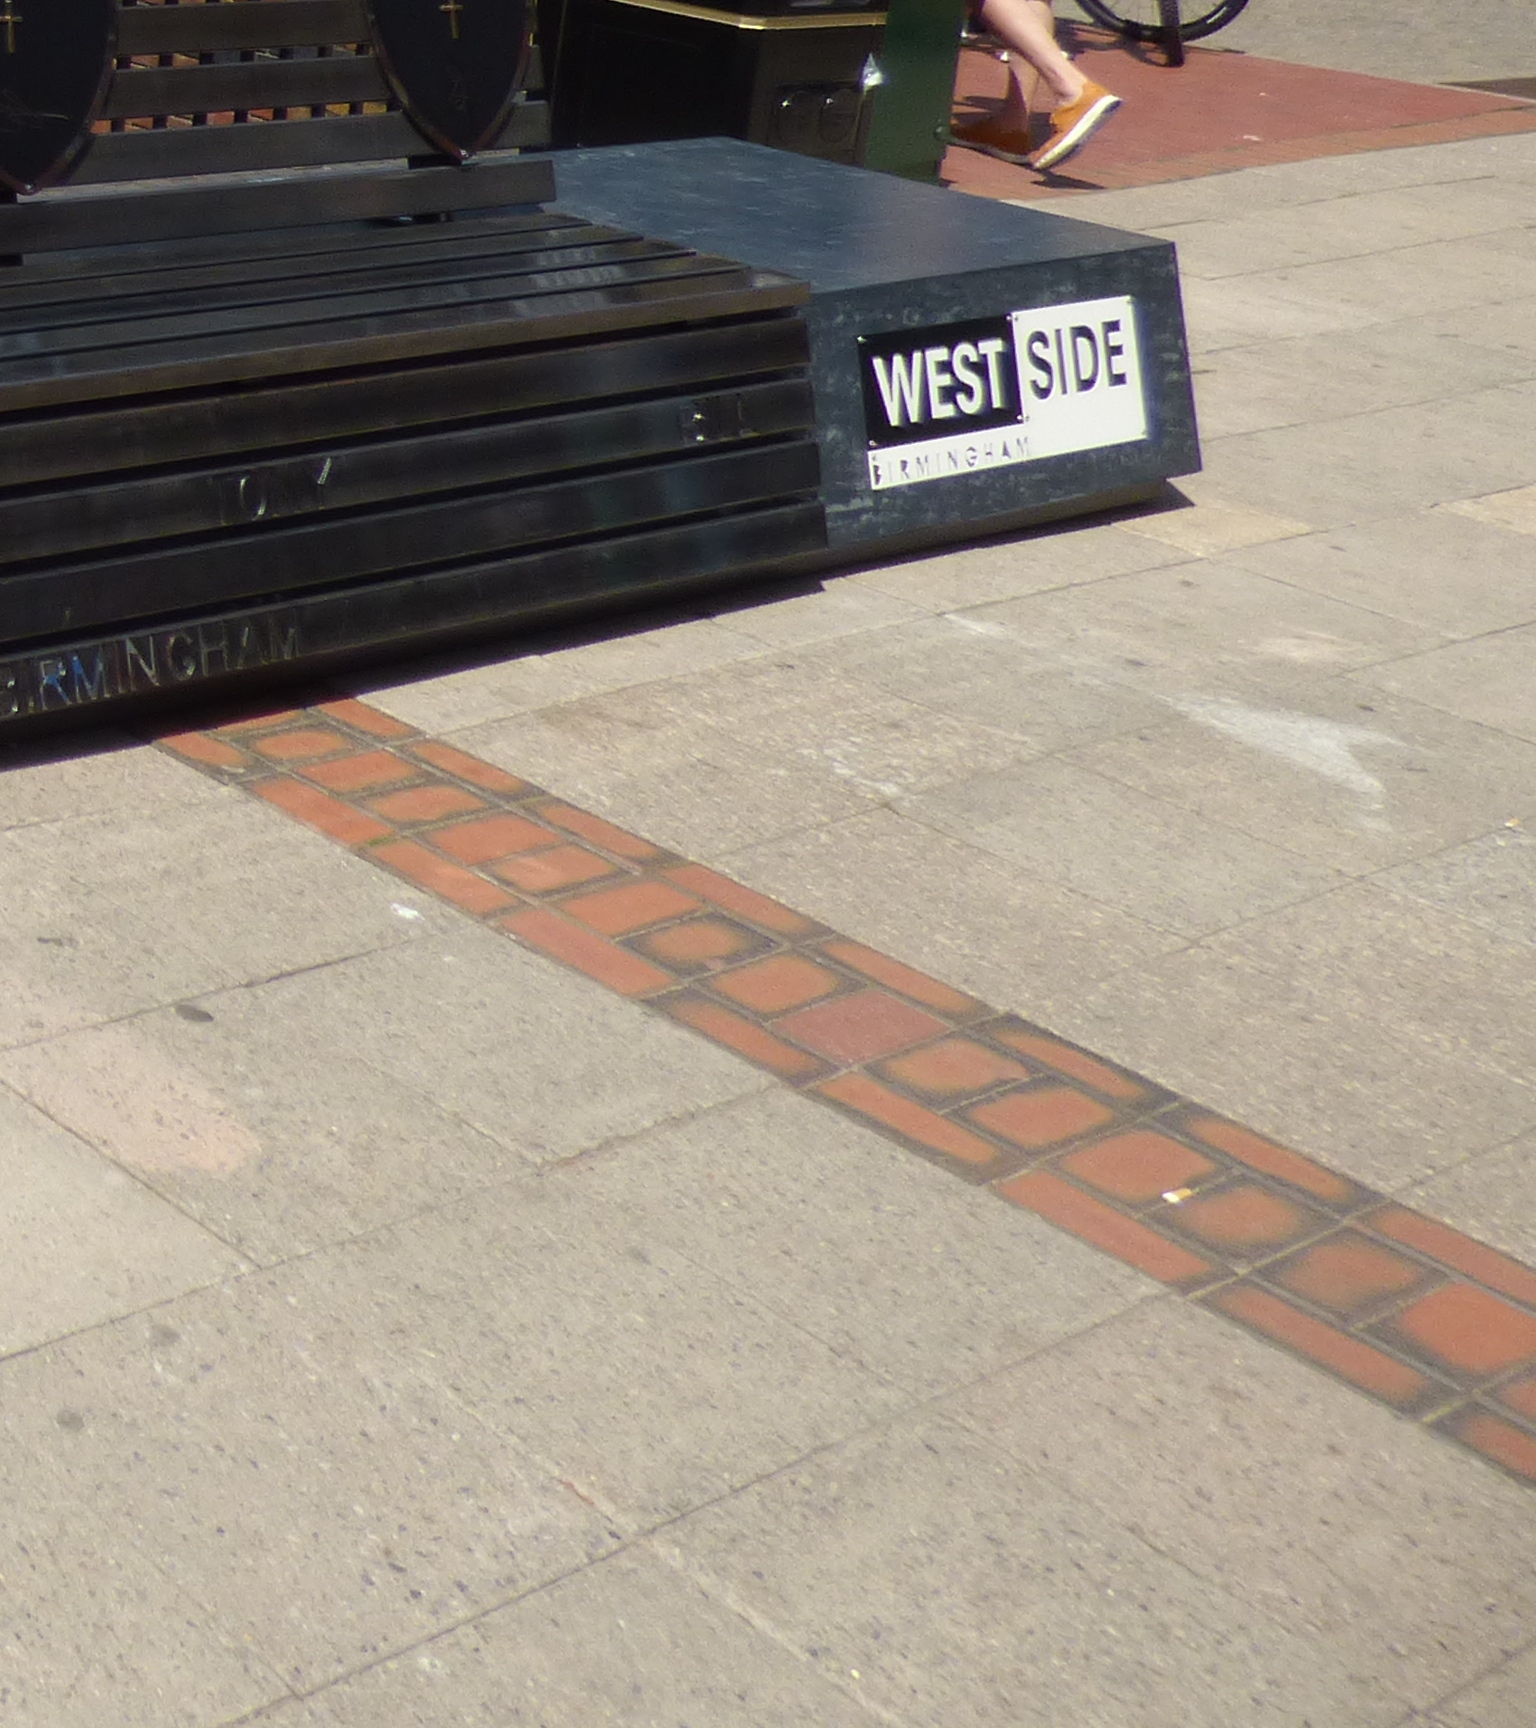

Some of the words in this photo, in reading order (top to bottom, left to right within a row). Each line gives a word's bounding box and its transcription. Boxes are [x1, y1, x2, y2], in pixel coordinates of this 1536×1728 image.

[872, 336, 1009, 428] WEST
[1025, 319, 1128, 402] SIDE
[872, 436, 1032, 486] BIRMINGHAM
